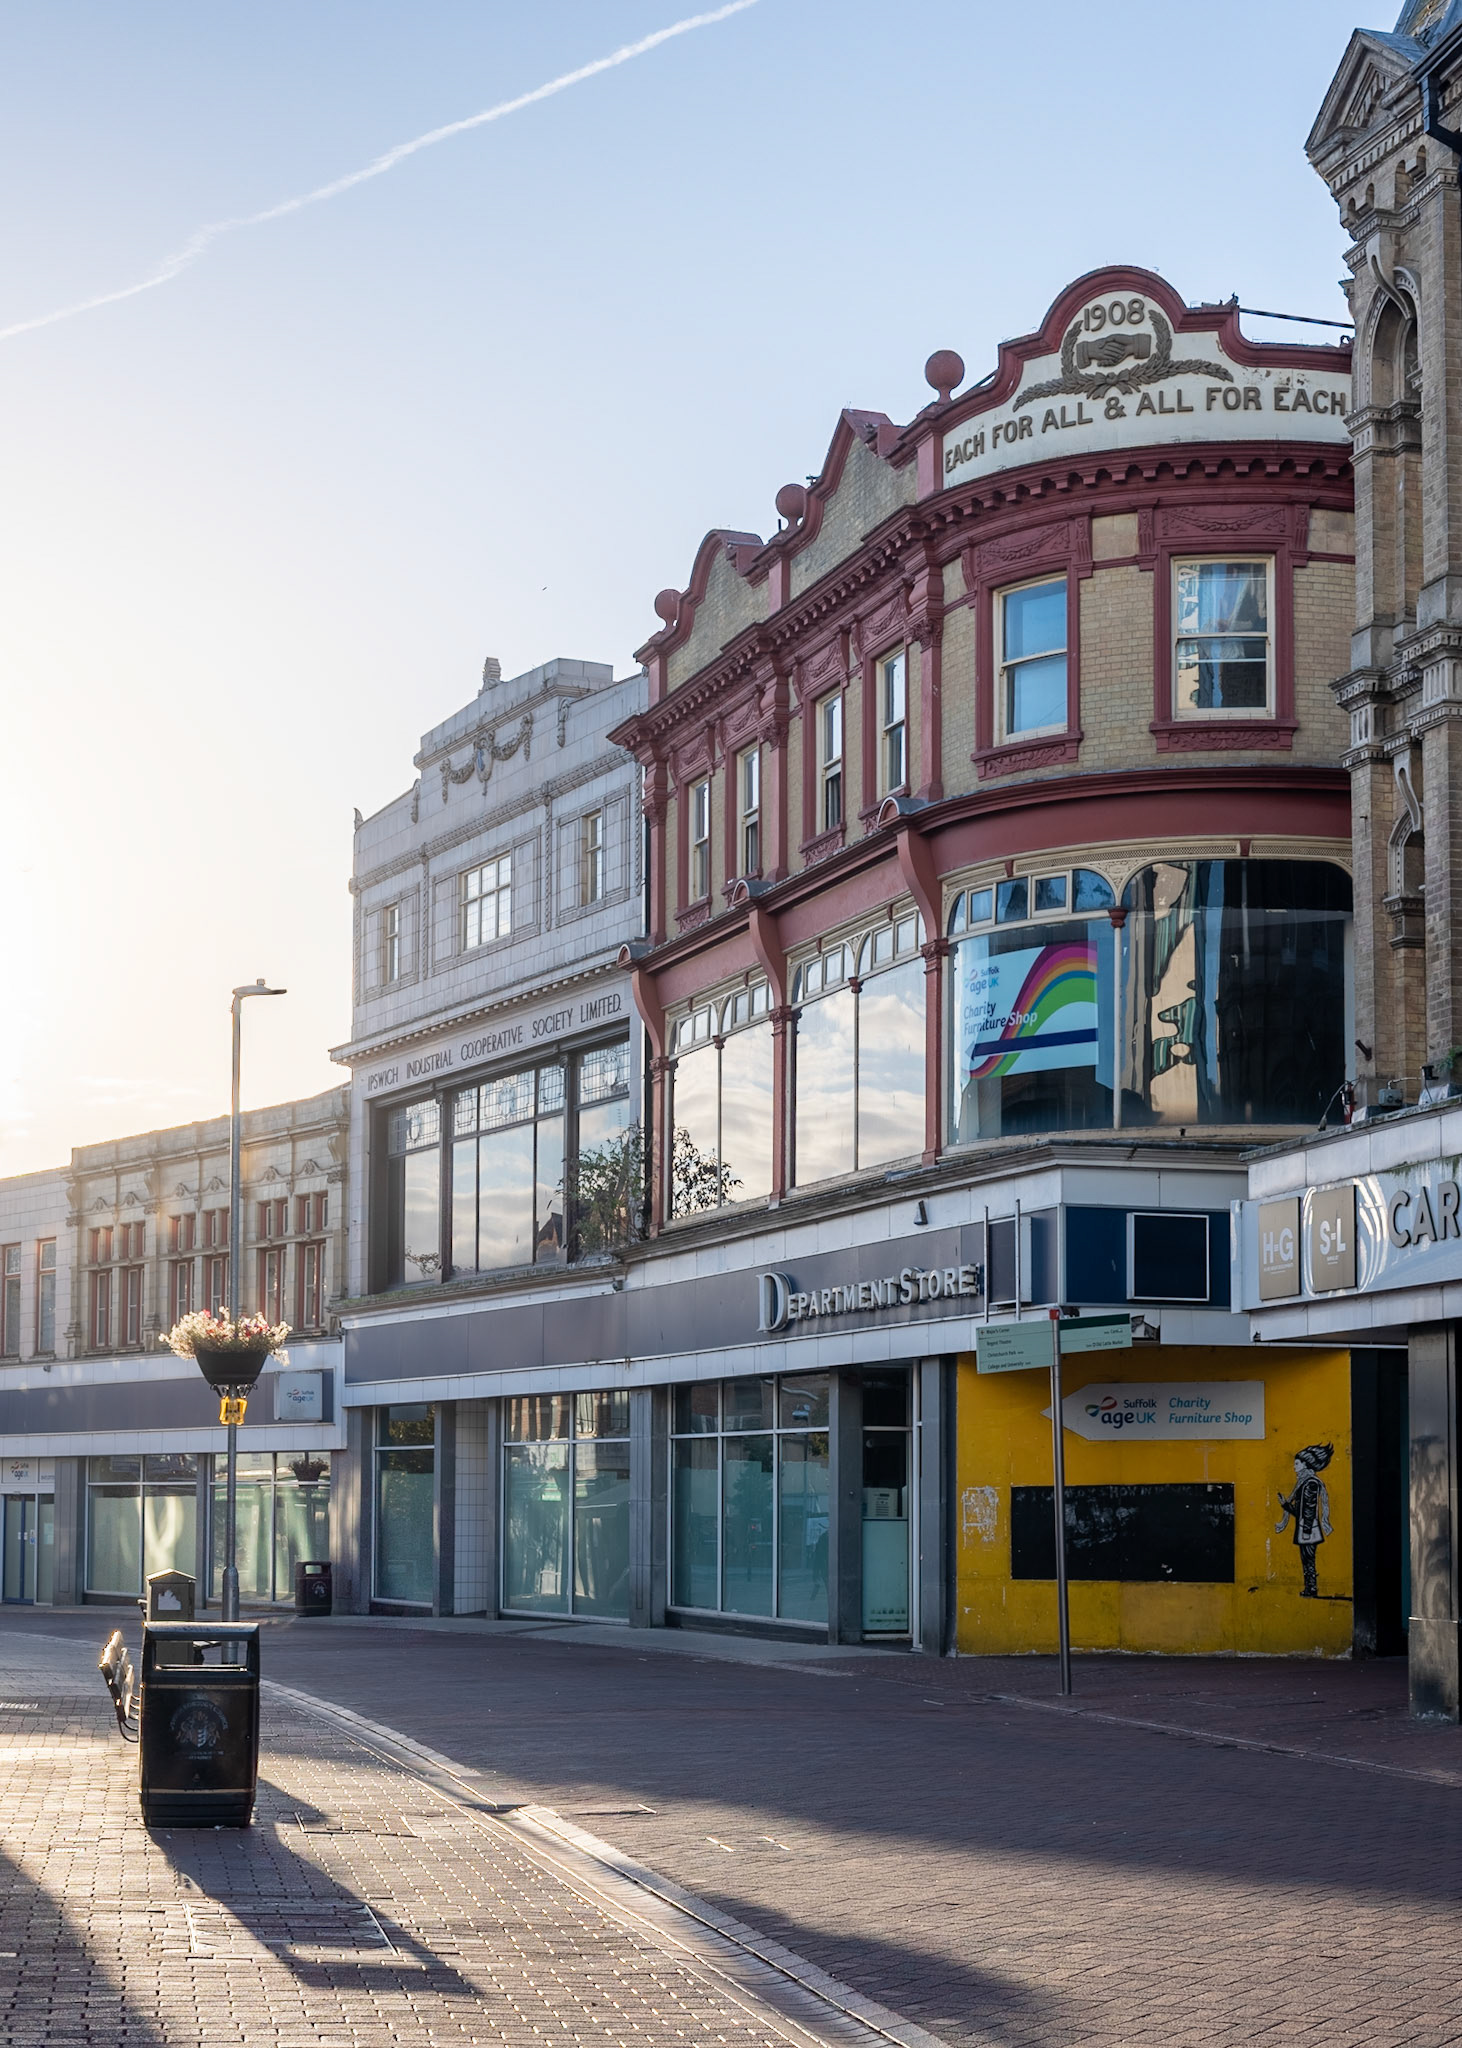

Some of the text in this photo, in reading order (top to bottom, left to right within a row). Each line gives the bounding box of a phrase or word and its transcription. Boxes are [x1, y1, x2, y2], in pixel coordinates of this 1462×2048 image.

[1084, 298, 1145, 332] 1908
[944, 387, 1346, 474] EACH FOR ALL & ALL FOR EACH
[964, 1001, 997, 1020] Charity
[964, 1011, 1038, 1036] Furniture Shop
[368, 1066, 399, 1092] IPSWICH
[406, 1049, 453, 1079] INDUSTRIAL
[532, 1008, 574, 1039] SOCIETY
[1388, 1181, 1461, 1249] CAR
[1123, 1398, 1157, 1409] Suffolk
[1169, 1397, 1211, 1410] Charity
[1169, 1412, 1253, 1426] Furniture Shop
